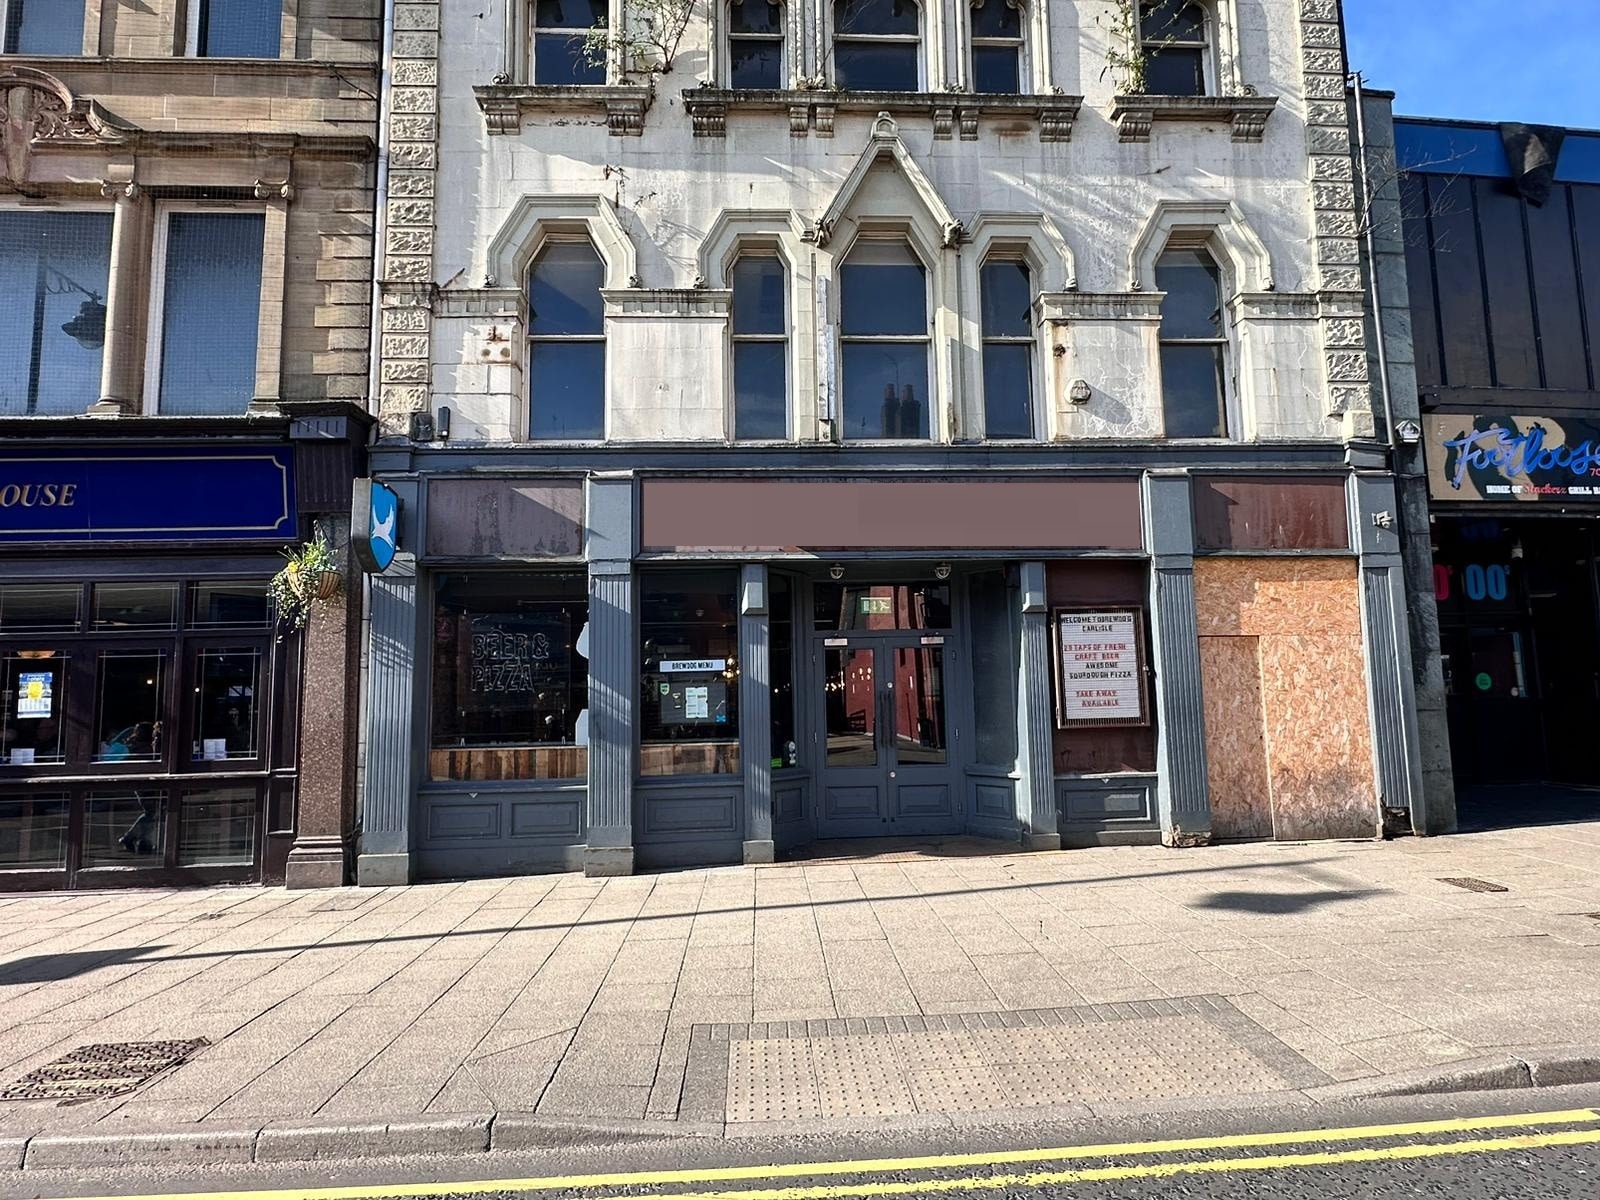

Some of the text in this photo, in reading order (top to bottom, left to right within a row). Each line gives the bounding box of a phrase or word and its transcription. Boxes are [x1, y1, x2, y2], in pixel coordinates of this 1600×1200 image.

[0, 483, 77, 507] OUSE
[1511, 485, 1523, 494] OF
[1568, 486, 1592, 495] GRILL
[1061, 616, 1091, 624] WELCOME
[472, 633, 549, 660] BEER &
[1074, 652, 1120, 661] CRAFT BEER
[672, 661, 714, 670] BREWDOG MENU
[471, 664, 534, 692] PIZZA
